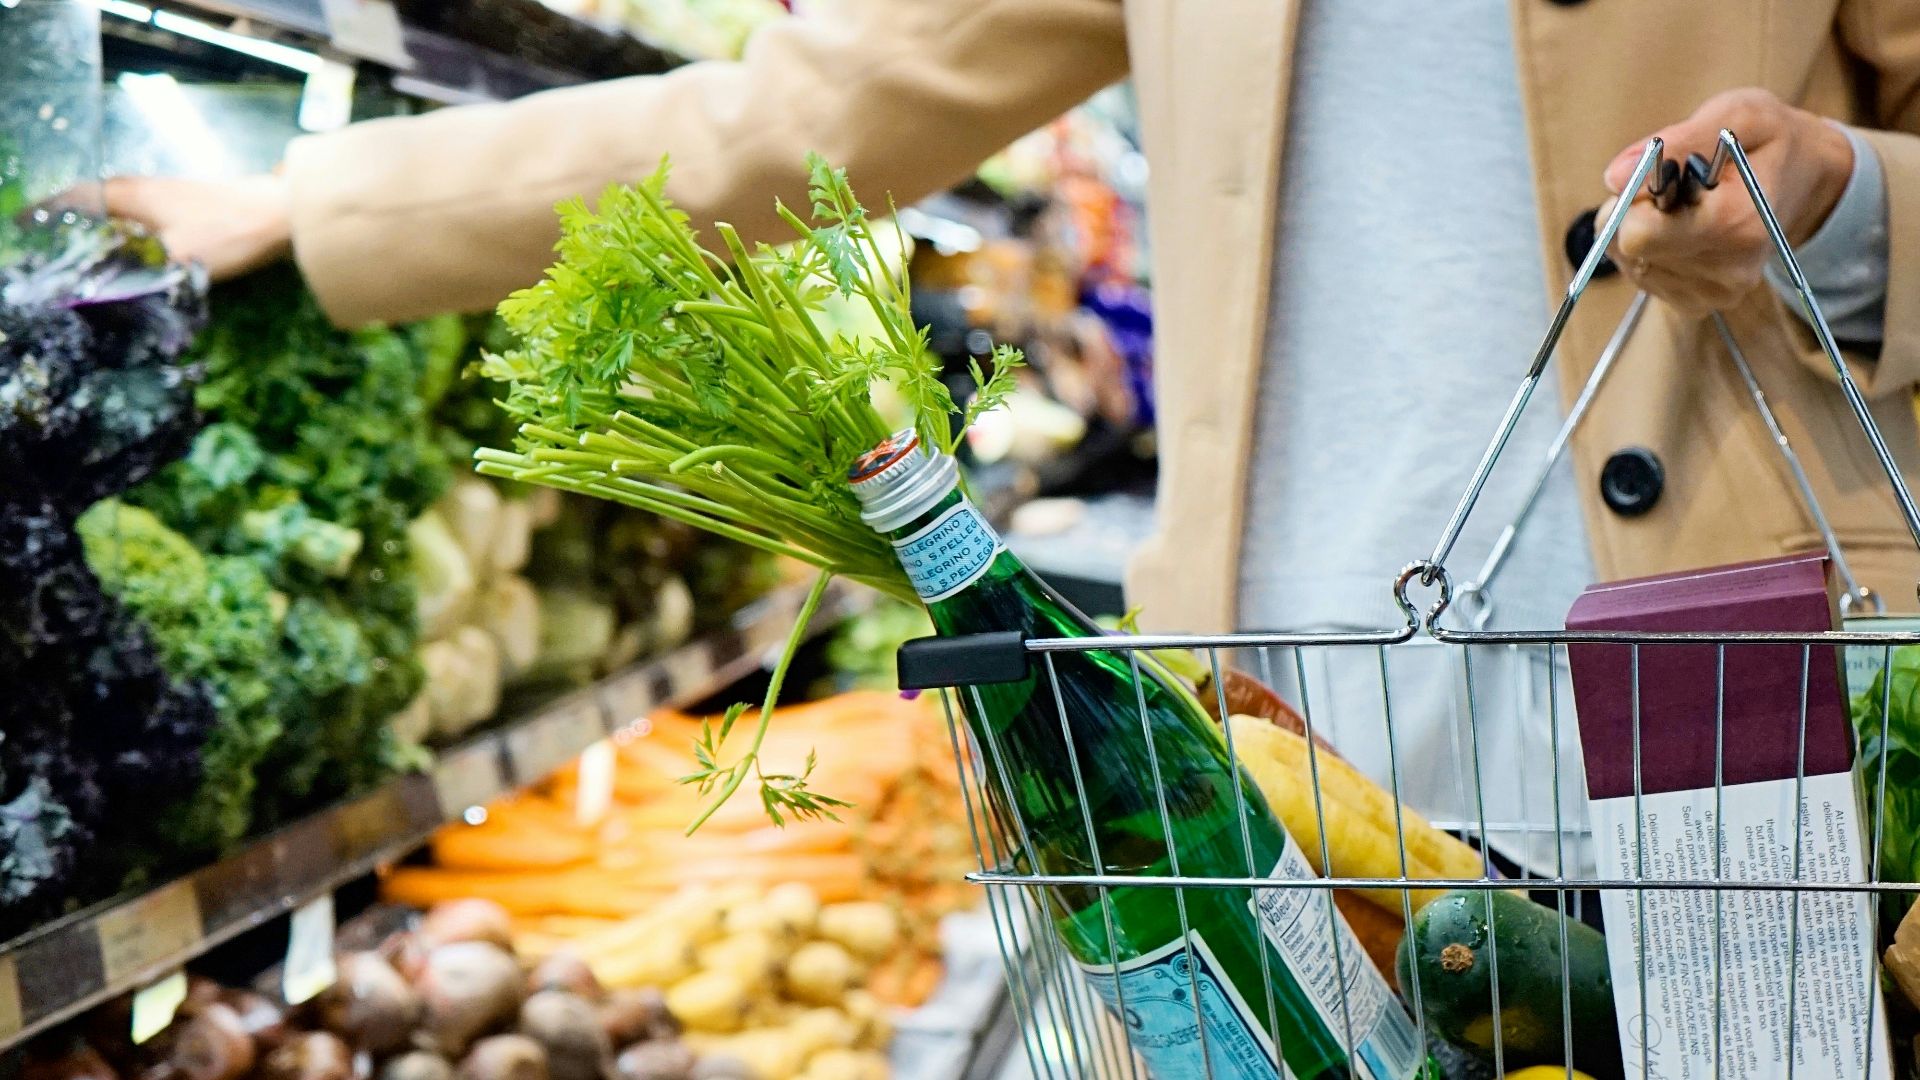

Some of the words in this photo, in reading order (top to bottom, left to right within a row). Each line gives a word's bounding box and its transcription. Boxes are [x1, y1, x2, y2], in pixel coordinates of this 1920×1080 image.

[1682, 805, 1692, 827] Seul
[1823, 801, 1834, 842] delicious
[1835, 810, 1844, 820] At
[1648, 813, 1659, 856] Délicieux
[1685, 829, 1692, 841] un
[1695, 819, 1703, 841] avec
[1755, 825, 1765, 840] but
[1766, 818, 1775, 845] these
[1836, 822, 1847, 853] Lesley
[1745, 825, 1755, 860] cheese
[1780, 844, 1789, 852] A
[1806, 839, 1814, 855] her
[1654, 858, 1661, 870] au
[1685, 843, 1699, 876] produit
[1697, 844, 1707, 866] soin,
[1758, 842, 1768, 867] really
[1769, 847, 1780, 879] unique
[1818, 853, 1826, 867] are
[1829, 844, 1839, 868] food.
[1702, 869, 1709, 881] en
[1749, 862, 1756, 871] or
[1808, 858, 1817, 882] team
[1617, 823, 1625, 845] vous
[1621, 848, 1627, 859] ne
[1625, 899, 1636, 919] plus
[1631, 921, 1639, 943] vous
[1266, 896, 1292, 926] Valeur
[1649, 898, 1657, 910] de
[1681, 889, 1694, 923] pouvait
[1765, 897, 1774, 922] when
[1802, 898, 1813, 932] scratch
[1824, 899, 1834, 918] with
[1672, 905, 1683, 936] POUR
[1705, 810, 1713, 822] de
[1721, 931, 1731, 970] fabuleux
[1726, 972, 1739, 1020] craquelins
[1733, 1022, 1742, 1042] sont
[1729, 911, 1740, 940] Foods
[1757, 920, 1766, 936] We
[1815, 909, 1823, 925] the
[1836, 901, 1846, 941] fabulous
[1849, 911, 1858, 940] Foods
[1651, 912, 1663, 959] trempette,
[1696, 914, 1709, 952] fabriqué
[1746, 923, 1754, 938] are
[1768, 925, 1780, 956] topped
[1779, 923, 1787, 938] are
[1816, 927, 1826, 946] only
[1827, 921, 1835, 941] care
[1664, 928, 1676, 976] craquelins
[1676, 938, 1686, 960] CES
[1688, 926, 1699, 966] satisfaire
[1733, 942, 1742, 969] adore
[1749, 941, 1757, 961] sure
[1806, 934, 1815, 959] using
[1830, 944, 1837, 952] in
[1840, 943, 1851, 971] crisps
[1853, 943, 1860, 956] we
[1644, 954, 1654, 980] nous,
[1658, 961, 1666, 973] de
[1702, 954, 1711, 976] avec
[1774, 959, 1782, 978] with
[1810, 961, 1818, 975] our
[1820, 949, 1828, 967] way
[1832, 955, 1842, 980] small
[1855, 959, 1863, 979] love
[1680, 963, 1690, 986] FINS
[1750, 963, 1760, 980] you
[1762, 957, 1774, 996] addicted
[1823, 969, 1830, 979] to
[1659, 975, 1670, 1014] fromage
[1670, 978, 1680, 998] sont
[1693, 969, 1703, 999] Lesley
[1706, 978, 1716, 995] des
[1737, 971, 1748, 1012] fabriquer
[1755, 983, 1764, 997] will
[1774, 980, 1784, 1000] your
[1813, 979, 1822, 1004] finest
[1825, 981, 1833, 1007] make
[1845, 973, 1854, 994] from
[1698, 1002, 1706, 1010] et
[1756, 1000, 1764, 1012] be
[1768, 998, 1775, 1007] to
[1835, 982, 1846, 1022] batches.
[1857, 981, 1870, 1015] making
[1665, 1016, 1671, 1028] ou
[1674, 1000, 1686, 1052] irrésistibles
[1683, 988, 1699, 1055] CRAQUELINS
[1699, 1014, 1707, 1030] son
[1743, 1015, 1751, 1024] et
[1769, 1010, 1777, 1027] this
[1848, 997, 1859, 1034] Lesley's
[1724, 1034, 1732, 1046] de
[1745, 1026, 1753, 1048] vous
[1815, 1006, 1829, 1057] ingredients.
[1827, 1018, 1838, 1042] great
[1770, 1029, 1781, 1062] yummy
[1796, 1046, 1804, 1065] own
[1853, 1036, 1865, 1070] kitchen
[1725, 1049, 1735, 1078] Lesley
[1830, 1044, 1844, 1079] product
